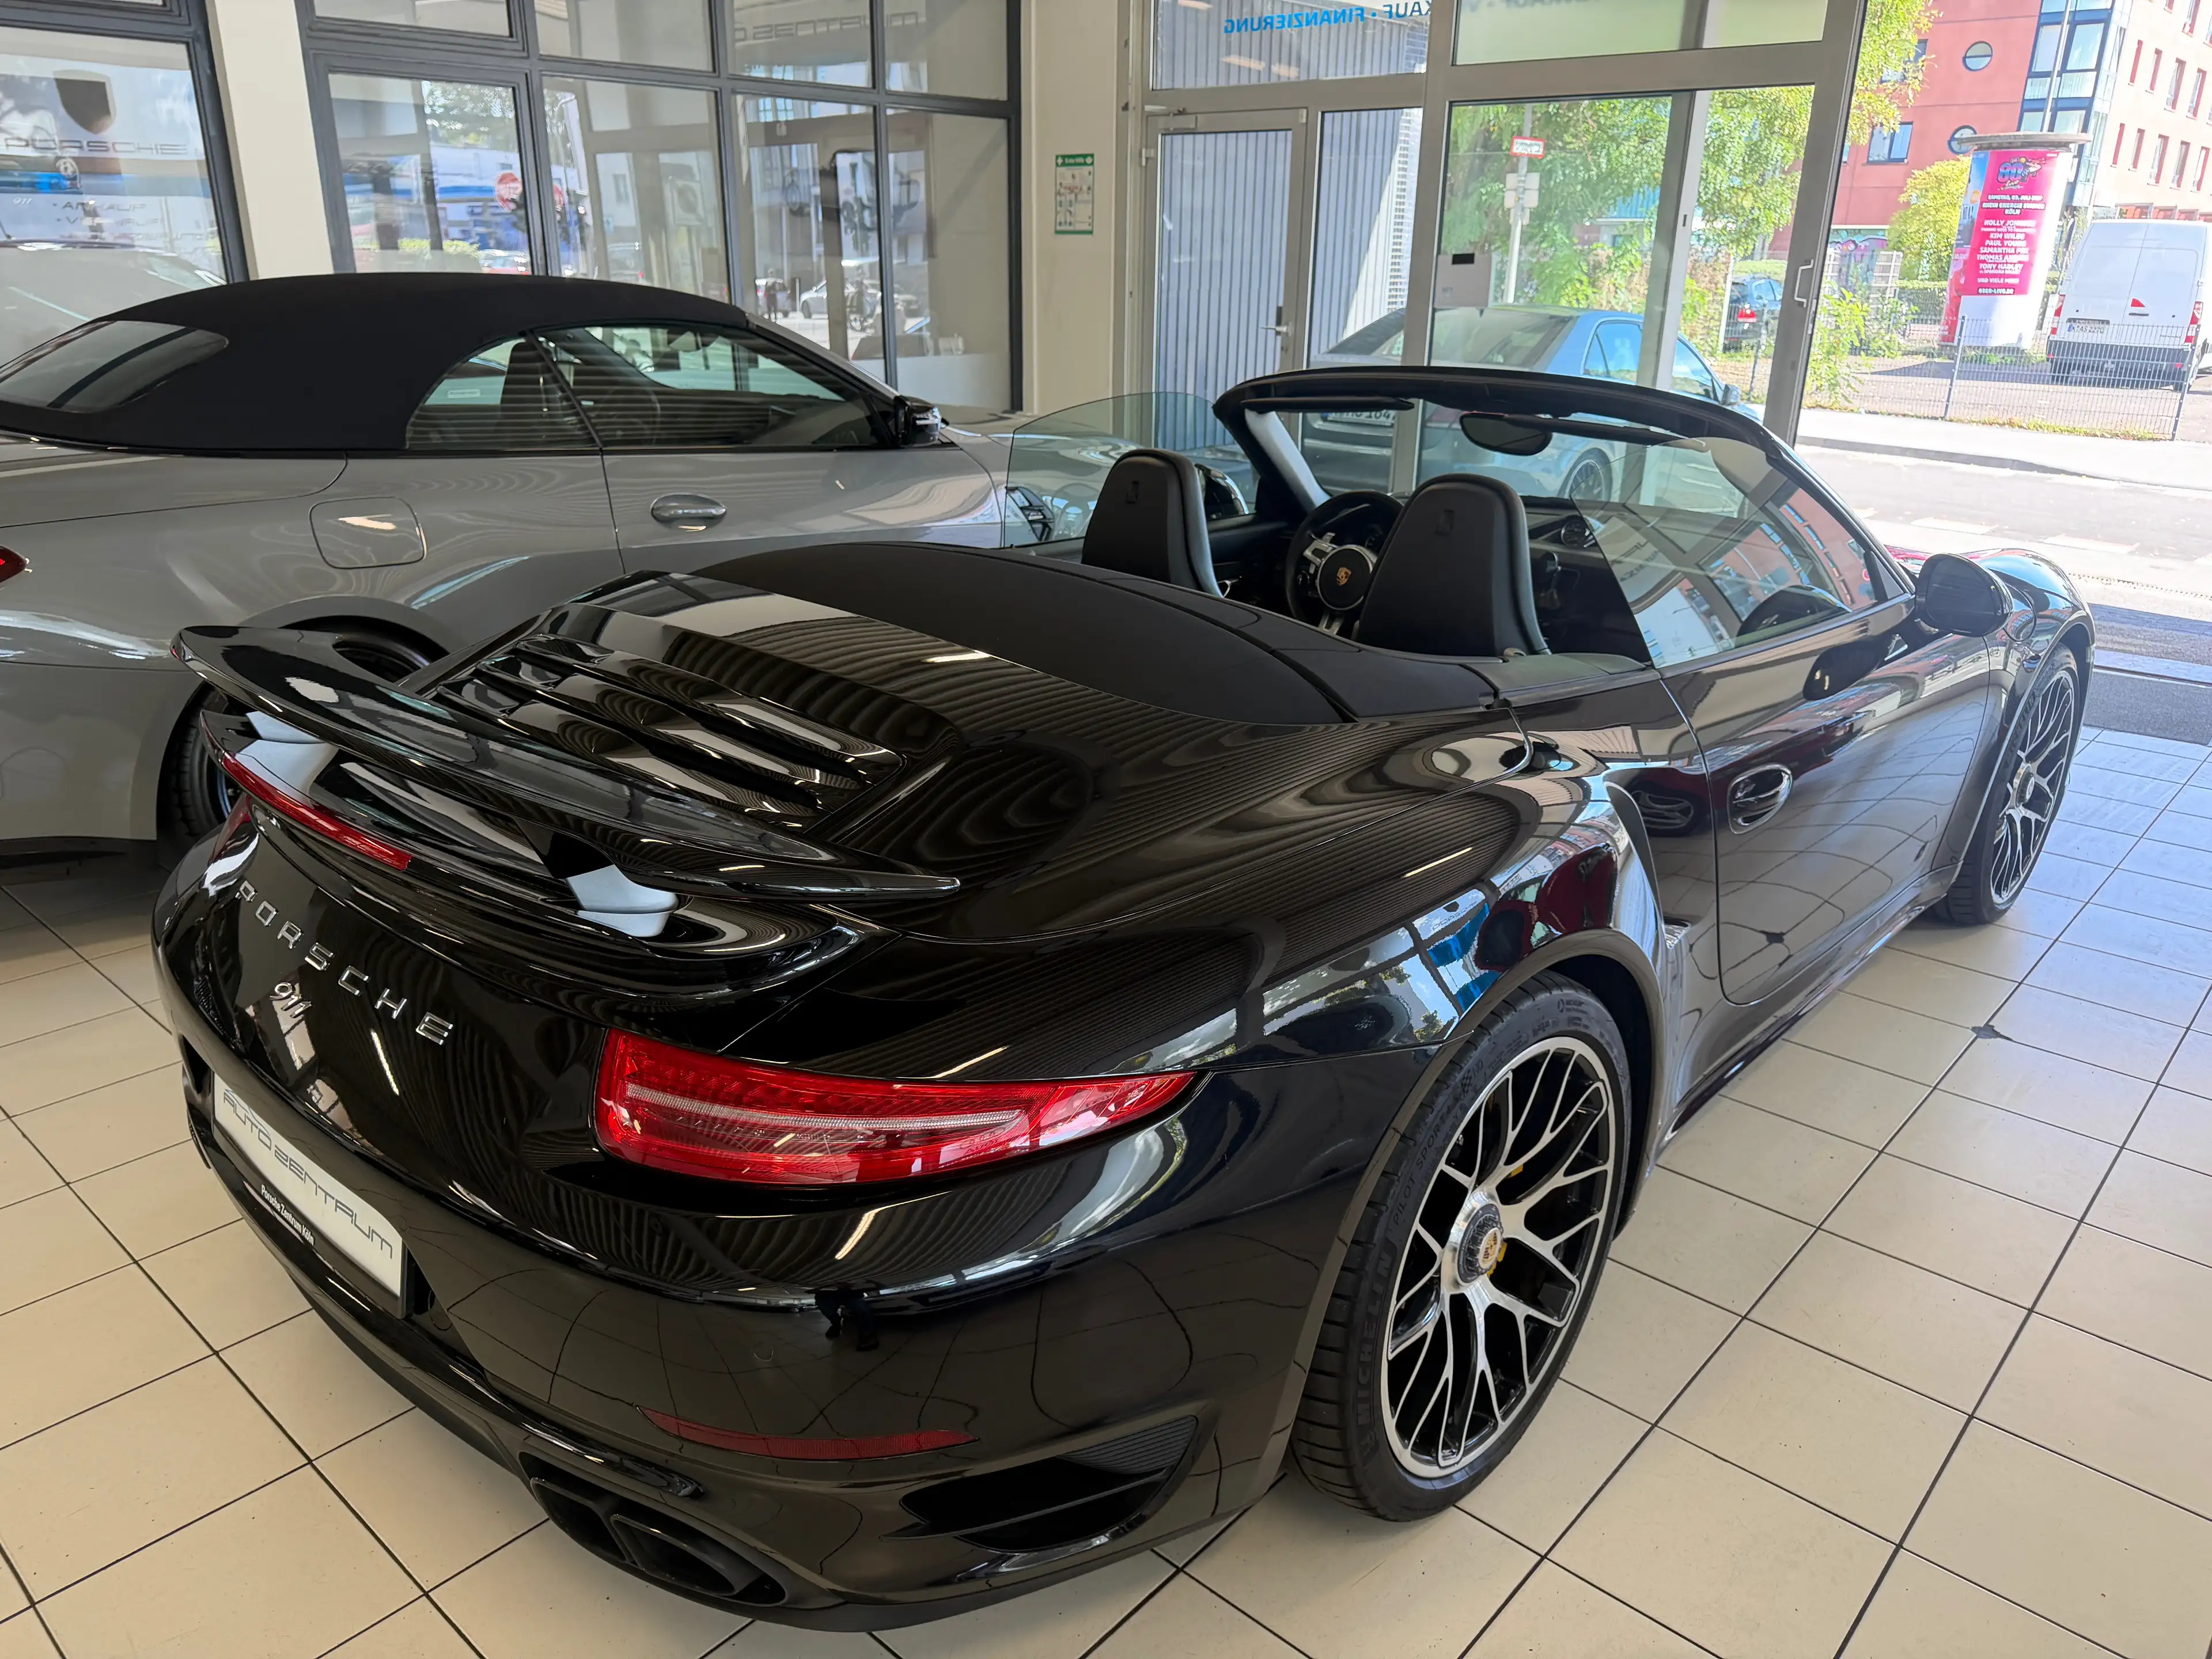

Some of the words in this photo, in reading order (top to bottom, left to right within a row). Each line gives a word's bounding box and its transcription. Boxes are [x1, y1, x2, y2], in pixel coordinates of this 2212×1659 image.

[4, 137, 189, 155] PORSCHE
[235, 880, 453, 1046] PORSCHE
[270, 982, 313, 1019] 911
[224, 1090, 271, 1152] AUTO
[1393, 1176, 1415, 1225] PILOT
[1416, 1112, 1448, 1171] SPORT
[262, 1184, 281, 1212] Porsche
[281, 1203, 302, 1233] Zentrum
[302, 1224, 314, 1246] Köln
[1356, 1246, 1392, 1427] MICHELIN
